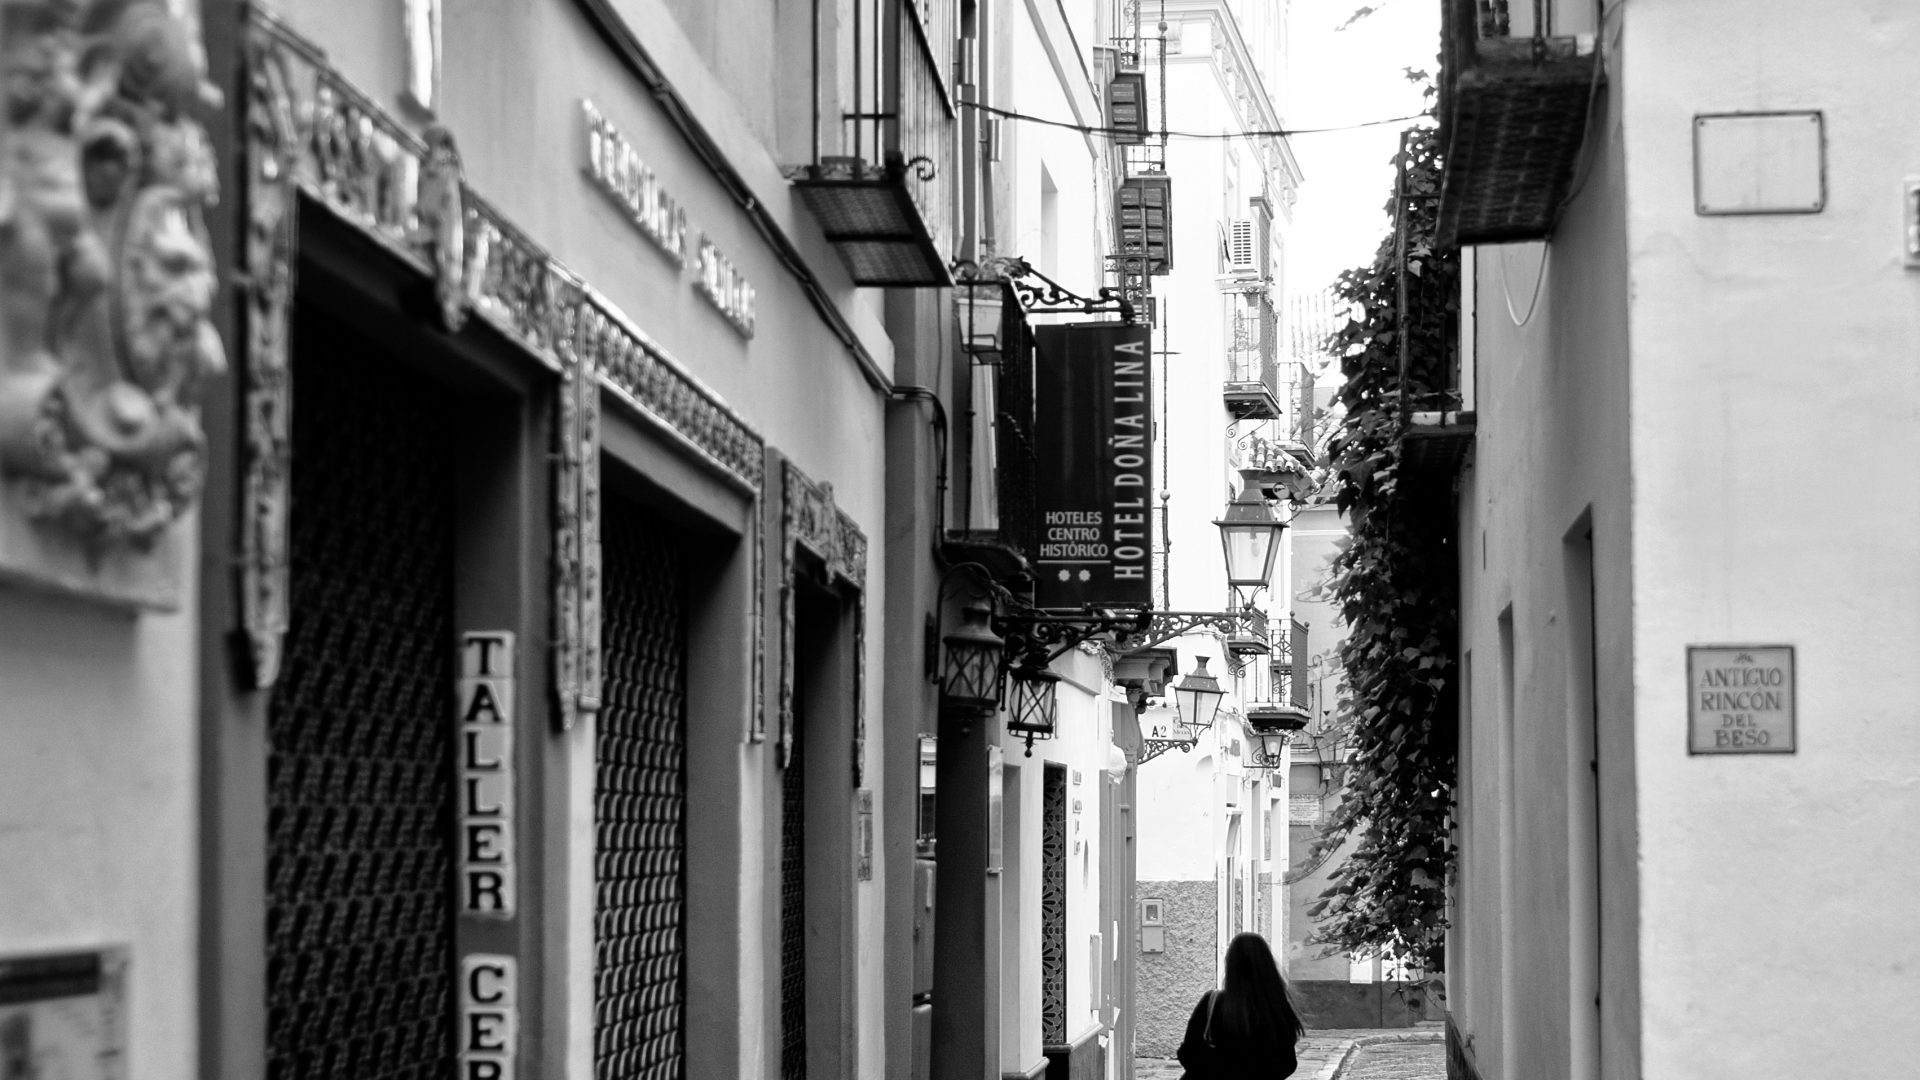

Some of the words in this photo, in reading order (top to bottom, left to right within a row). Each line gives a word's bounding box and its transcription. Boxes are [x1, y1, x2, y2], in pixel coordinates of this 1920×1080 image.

[1113, 340, 1145, 403] LINA
[1107, 413, 1145, 487] DOÑA
[1045, 511, 1103, 525] HOTELES
[1047, 527, 1101, 541] CENTRO
[1113, 497, 1145, 579] HOTEL
[1039, 541, 1109, 557] HISTÓRICO
[1700, 666, 1784, 687] ANTIGUO
[1701, 686, 1782, 711] RINCÓN
[1721, 713, 1757, 728] DEL
[1713, 729, 1770, 748] BESO
[465, 636, 505, 911] TALLER
